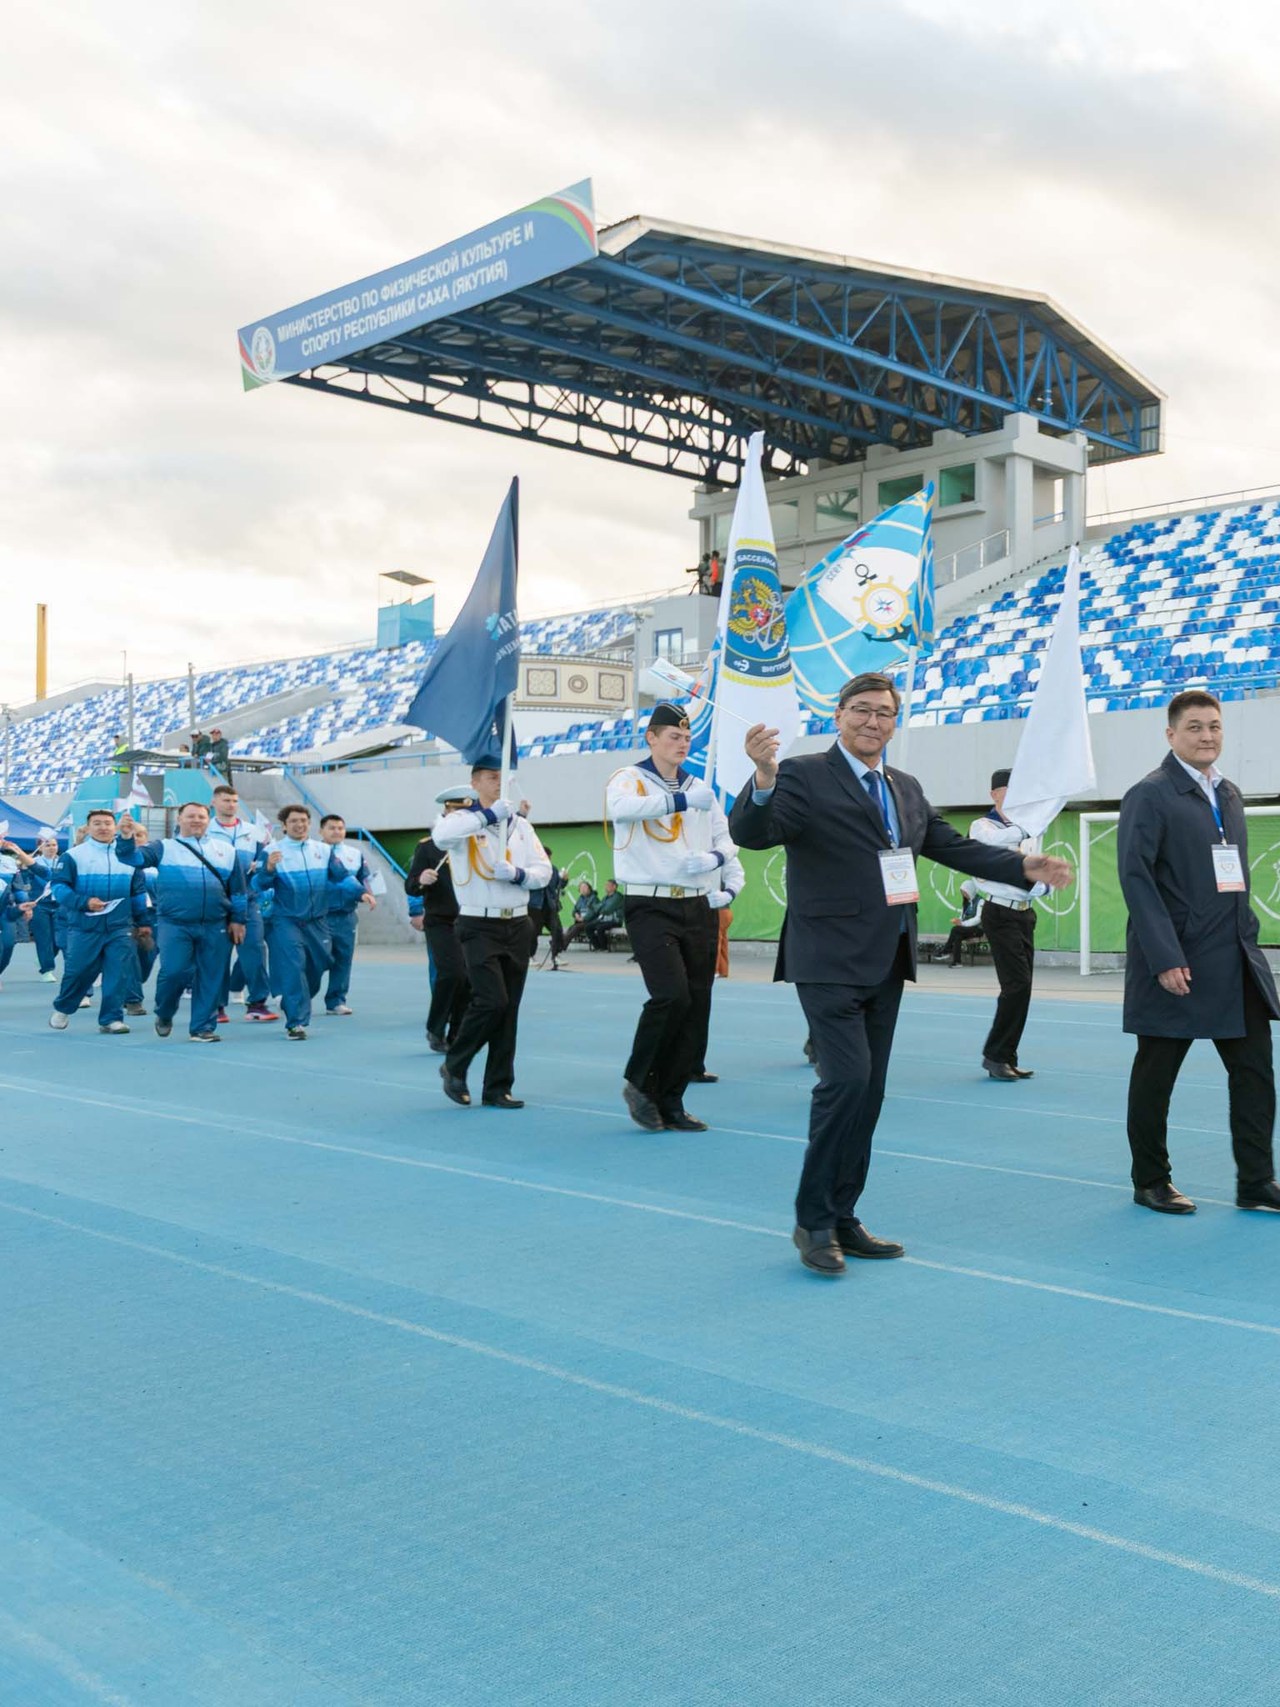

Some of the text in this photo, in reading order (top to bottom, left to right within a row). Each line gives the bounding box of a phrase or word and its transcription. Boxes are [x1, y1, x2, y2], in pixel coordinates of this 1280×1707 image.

[277, 220, 534, 342] МИНИСТЕРСТВО ПО ФИЗИЧЕСКОЙ КУЛЬТУРЕ И
[301, 259, 508, 357] СПОРТУ РЕСПУБЛИКИ САХА (ЯКУТИЯ)
